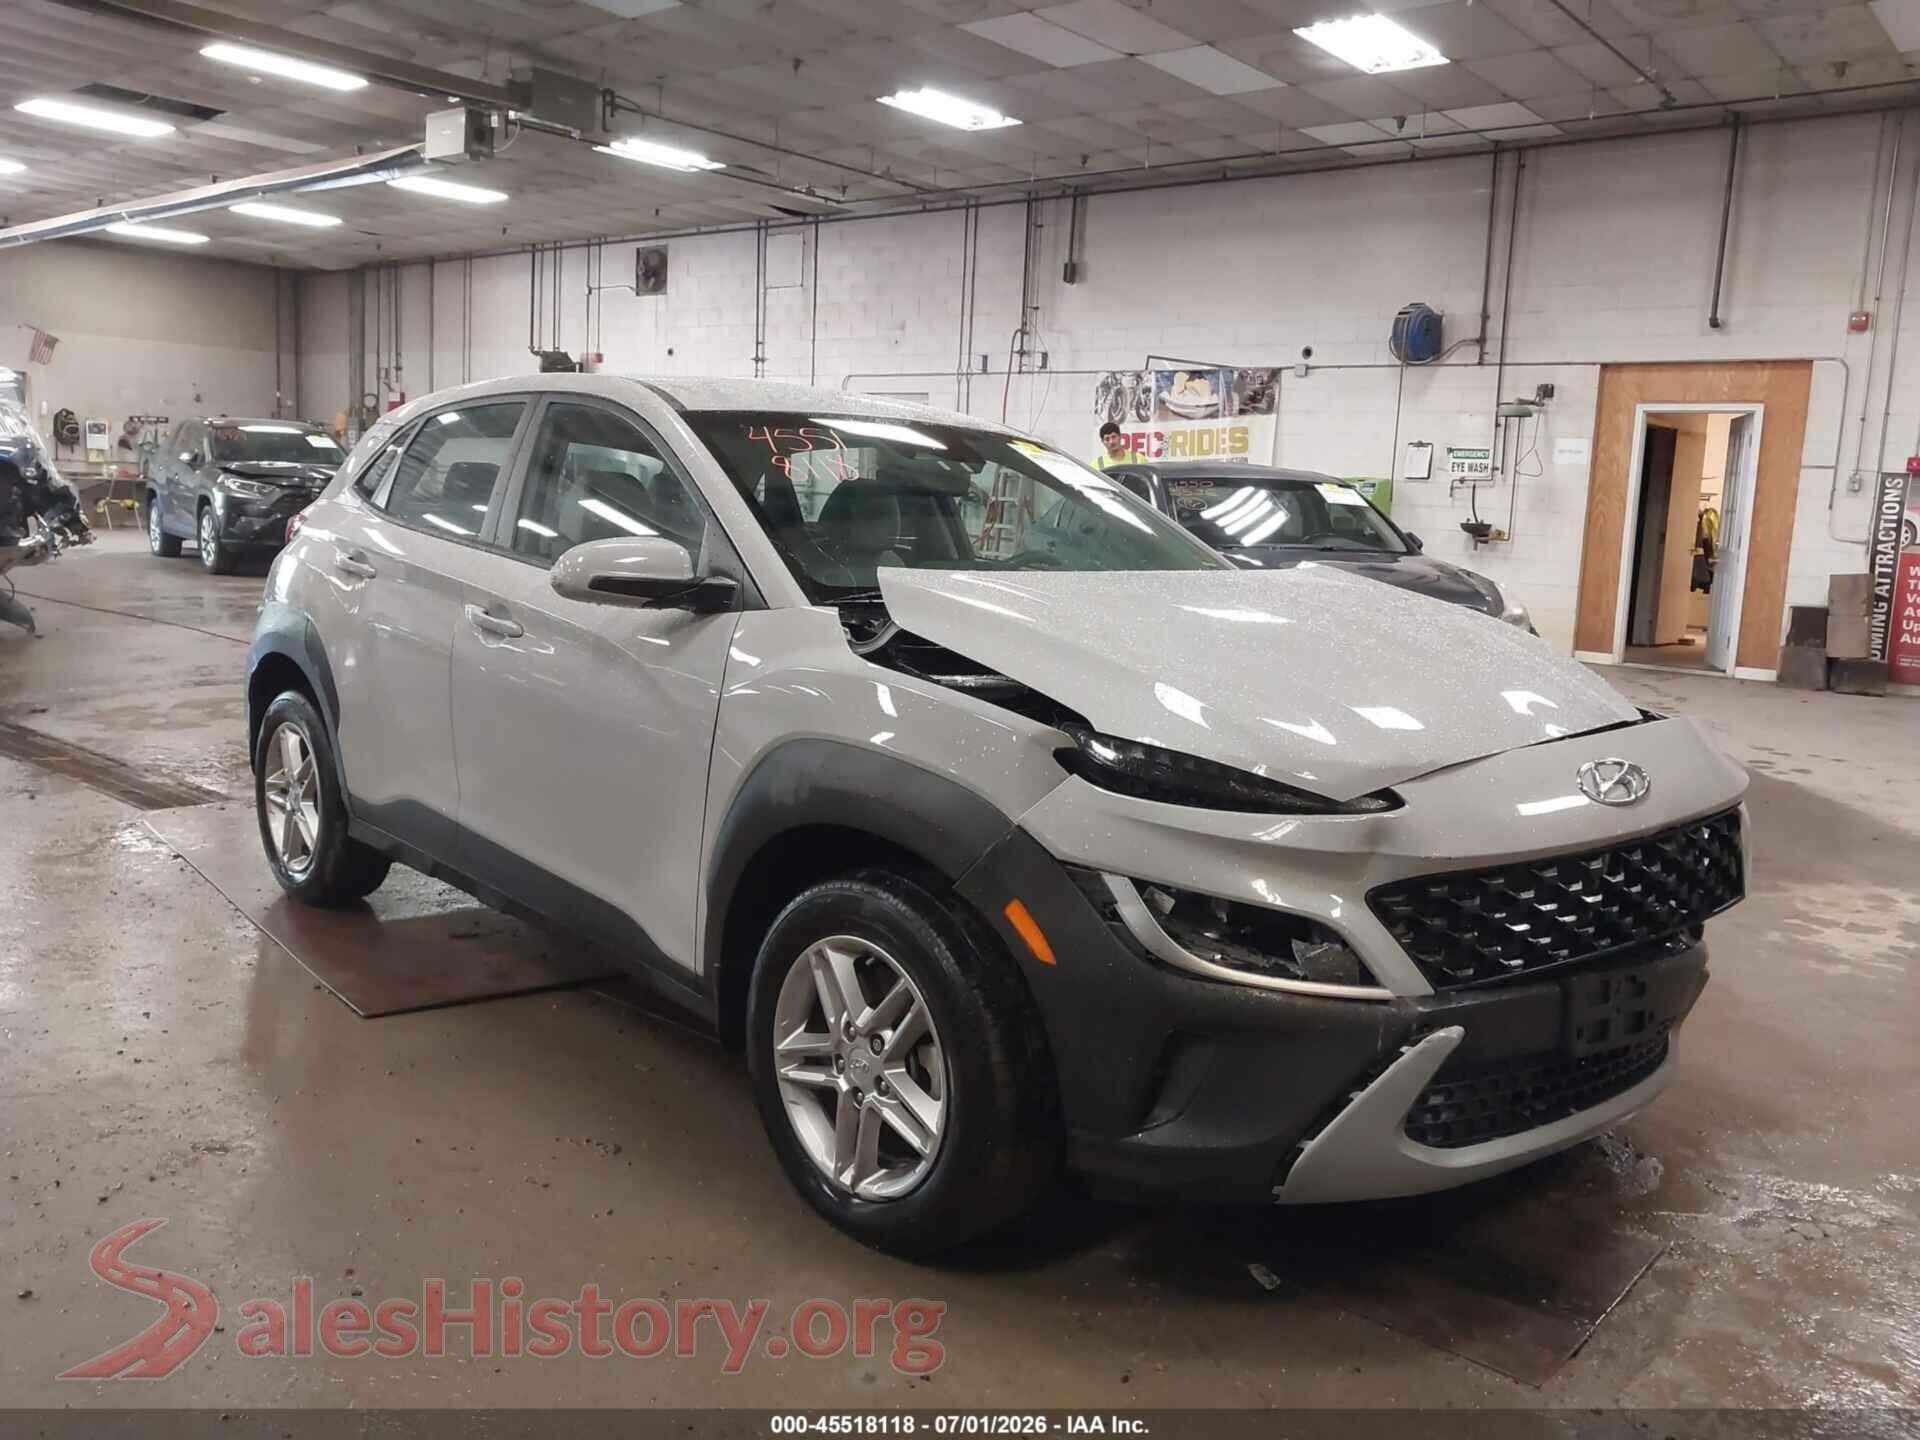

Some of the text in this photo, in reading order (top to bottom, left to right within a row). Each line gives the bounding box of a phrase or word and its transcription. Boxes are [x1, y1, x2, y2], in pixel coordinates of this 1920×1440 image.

[1169, 426, 1249, 457] RIDES
[1451, 462, 1489, 473] EYE WASH
[1875, 478, 1904, 598] ATTRACTIONS
